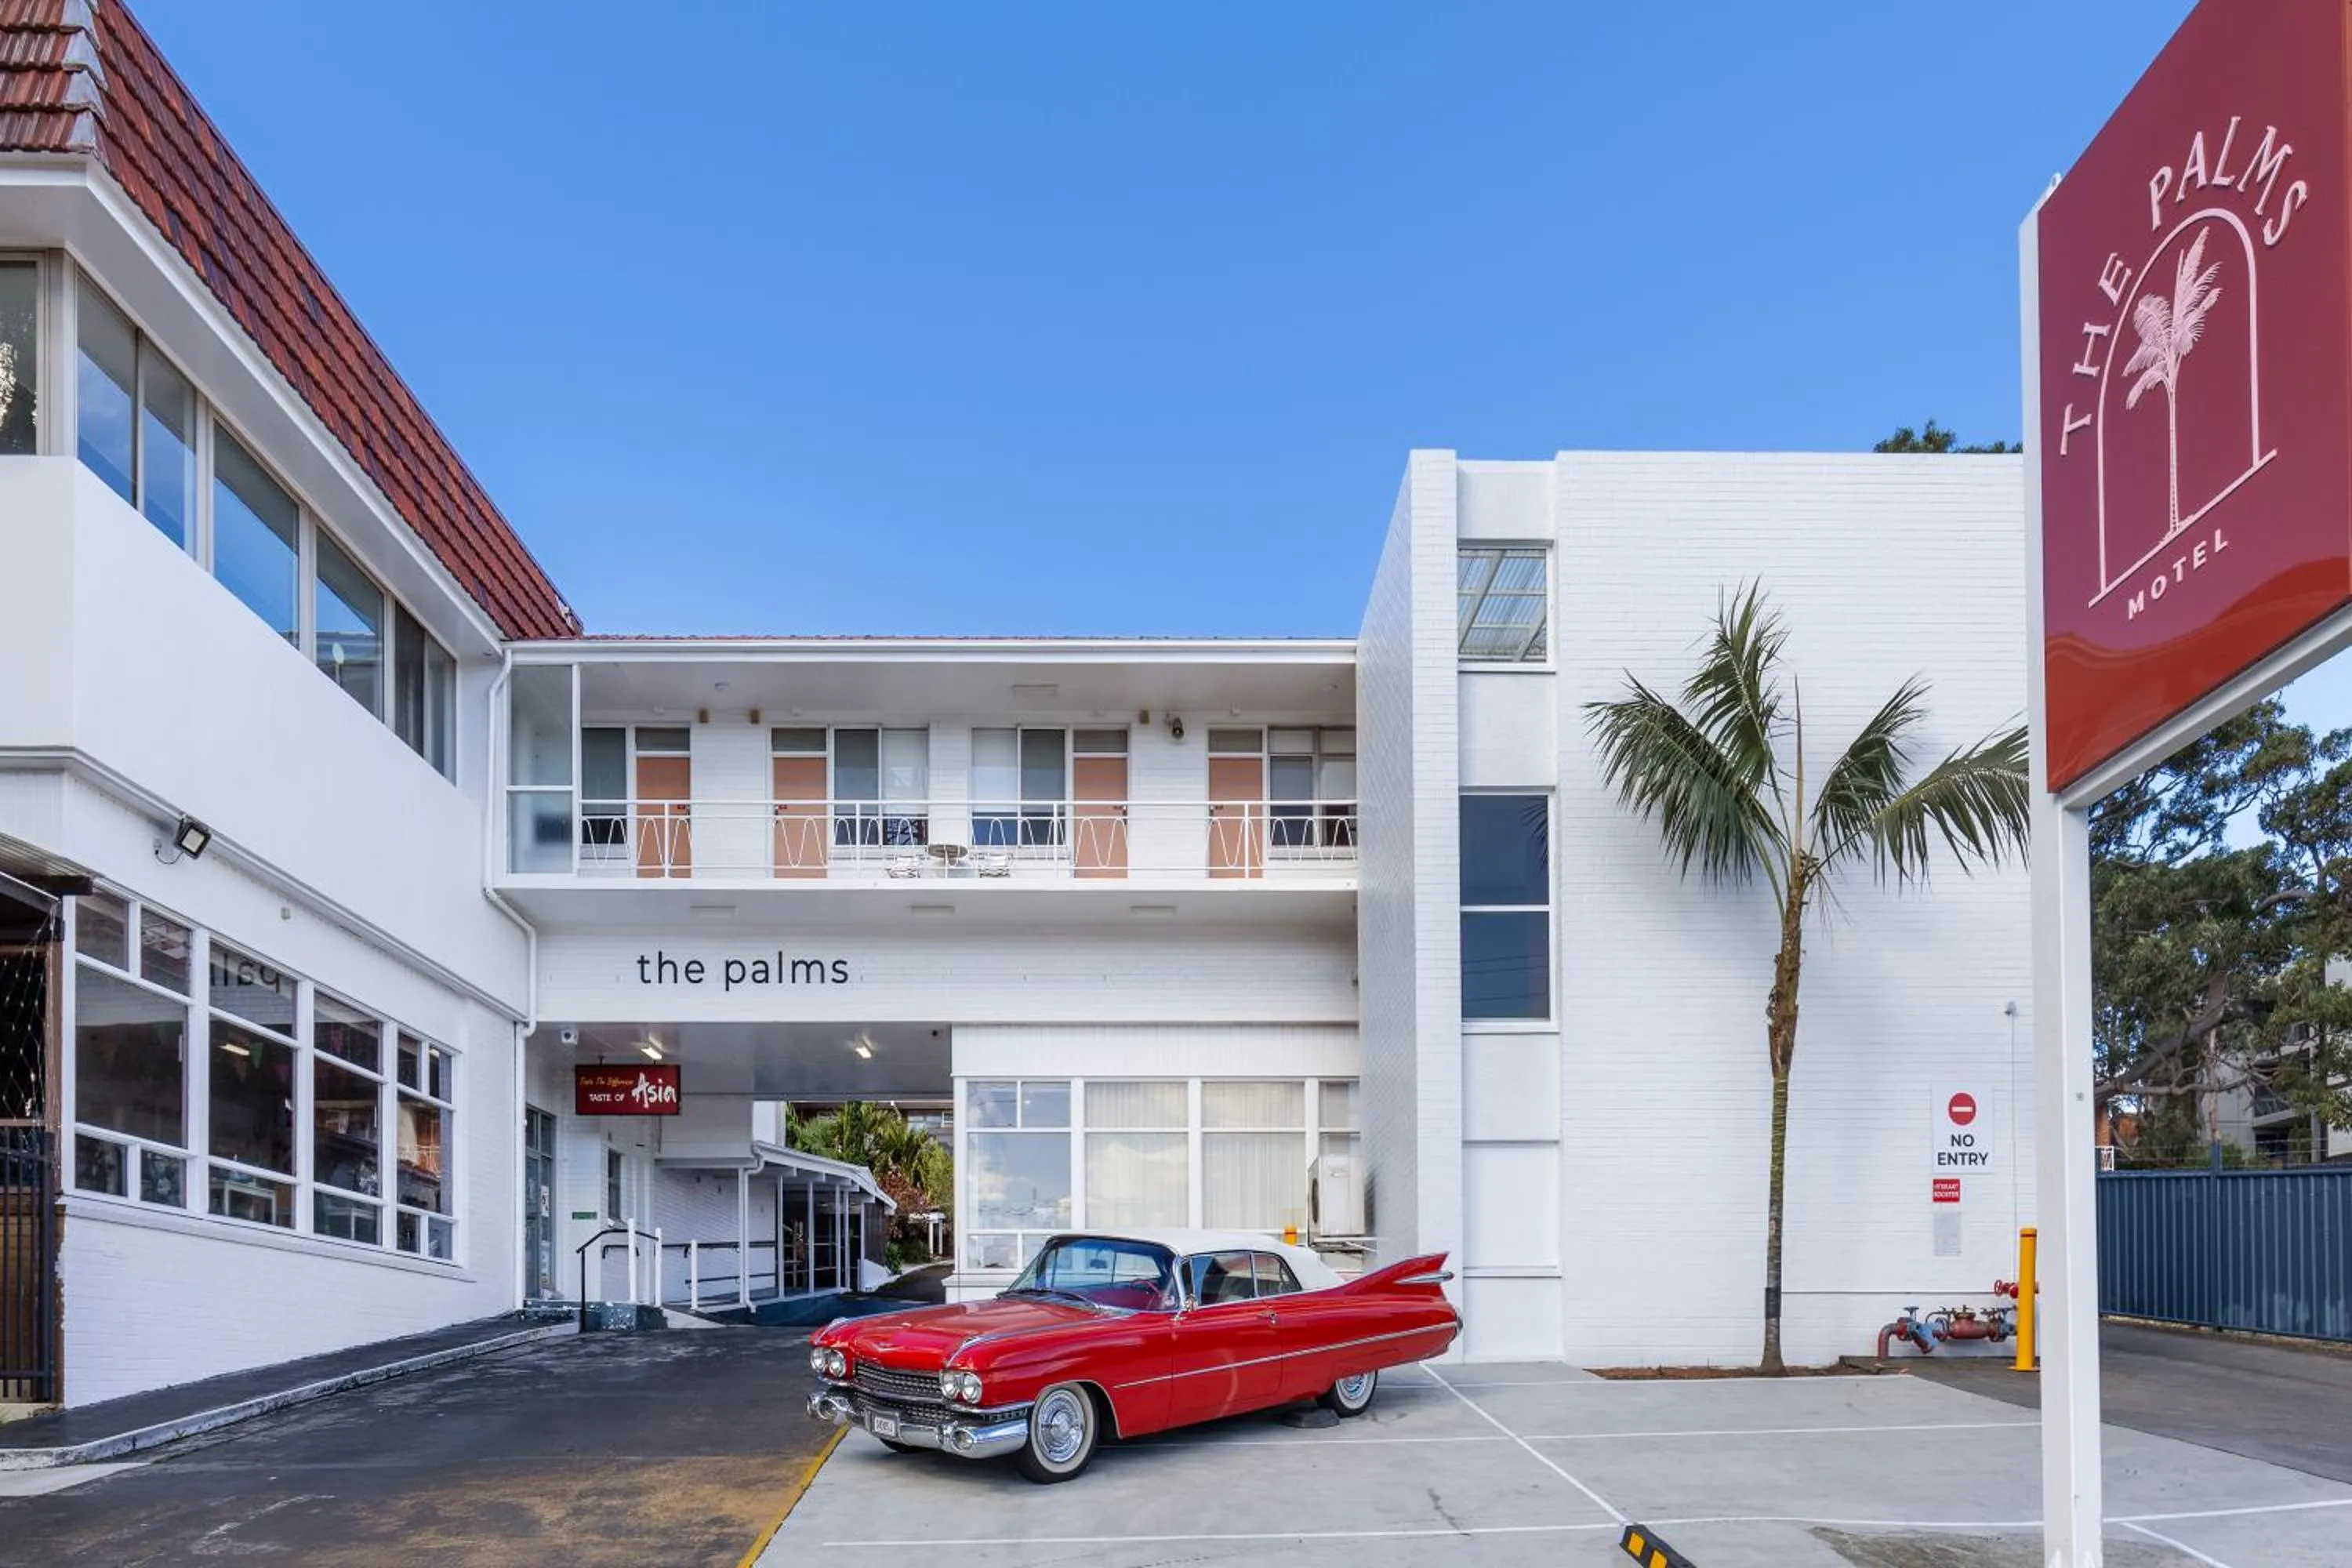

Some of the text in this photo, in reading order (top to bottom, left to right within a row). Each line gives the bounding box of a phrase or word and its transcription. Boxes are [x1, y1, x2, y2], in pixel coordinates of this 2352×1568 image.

[2059, 115, 2307, 457] THE PALMS
[2126, 528, 2229, 622] MOTEL
[637, 951, 849, 992] the palms
[589, 1094, 612, 1102] TASTE
[631, 1072, 677, 1109] Asia
[1936, 1152, 1989, 1166] ENTRY
[1950, 1134, 1975, 1147] NO
